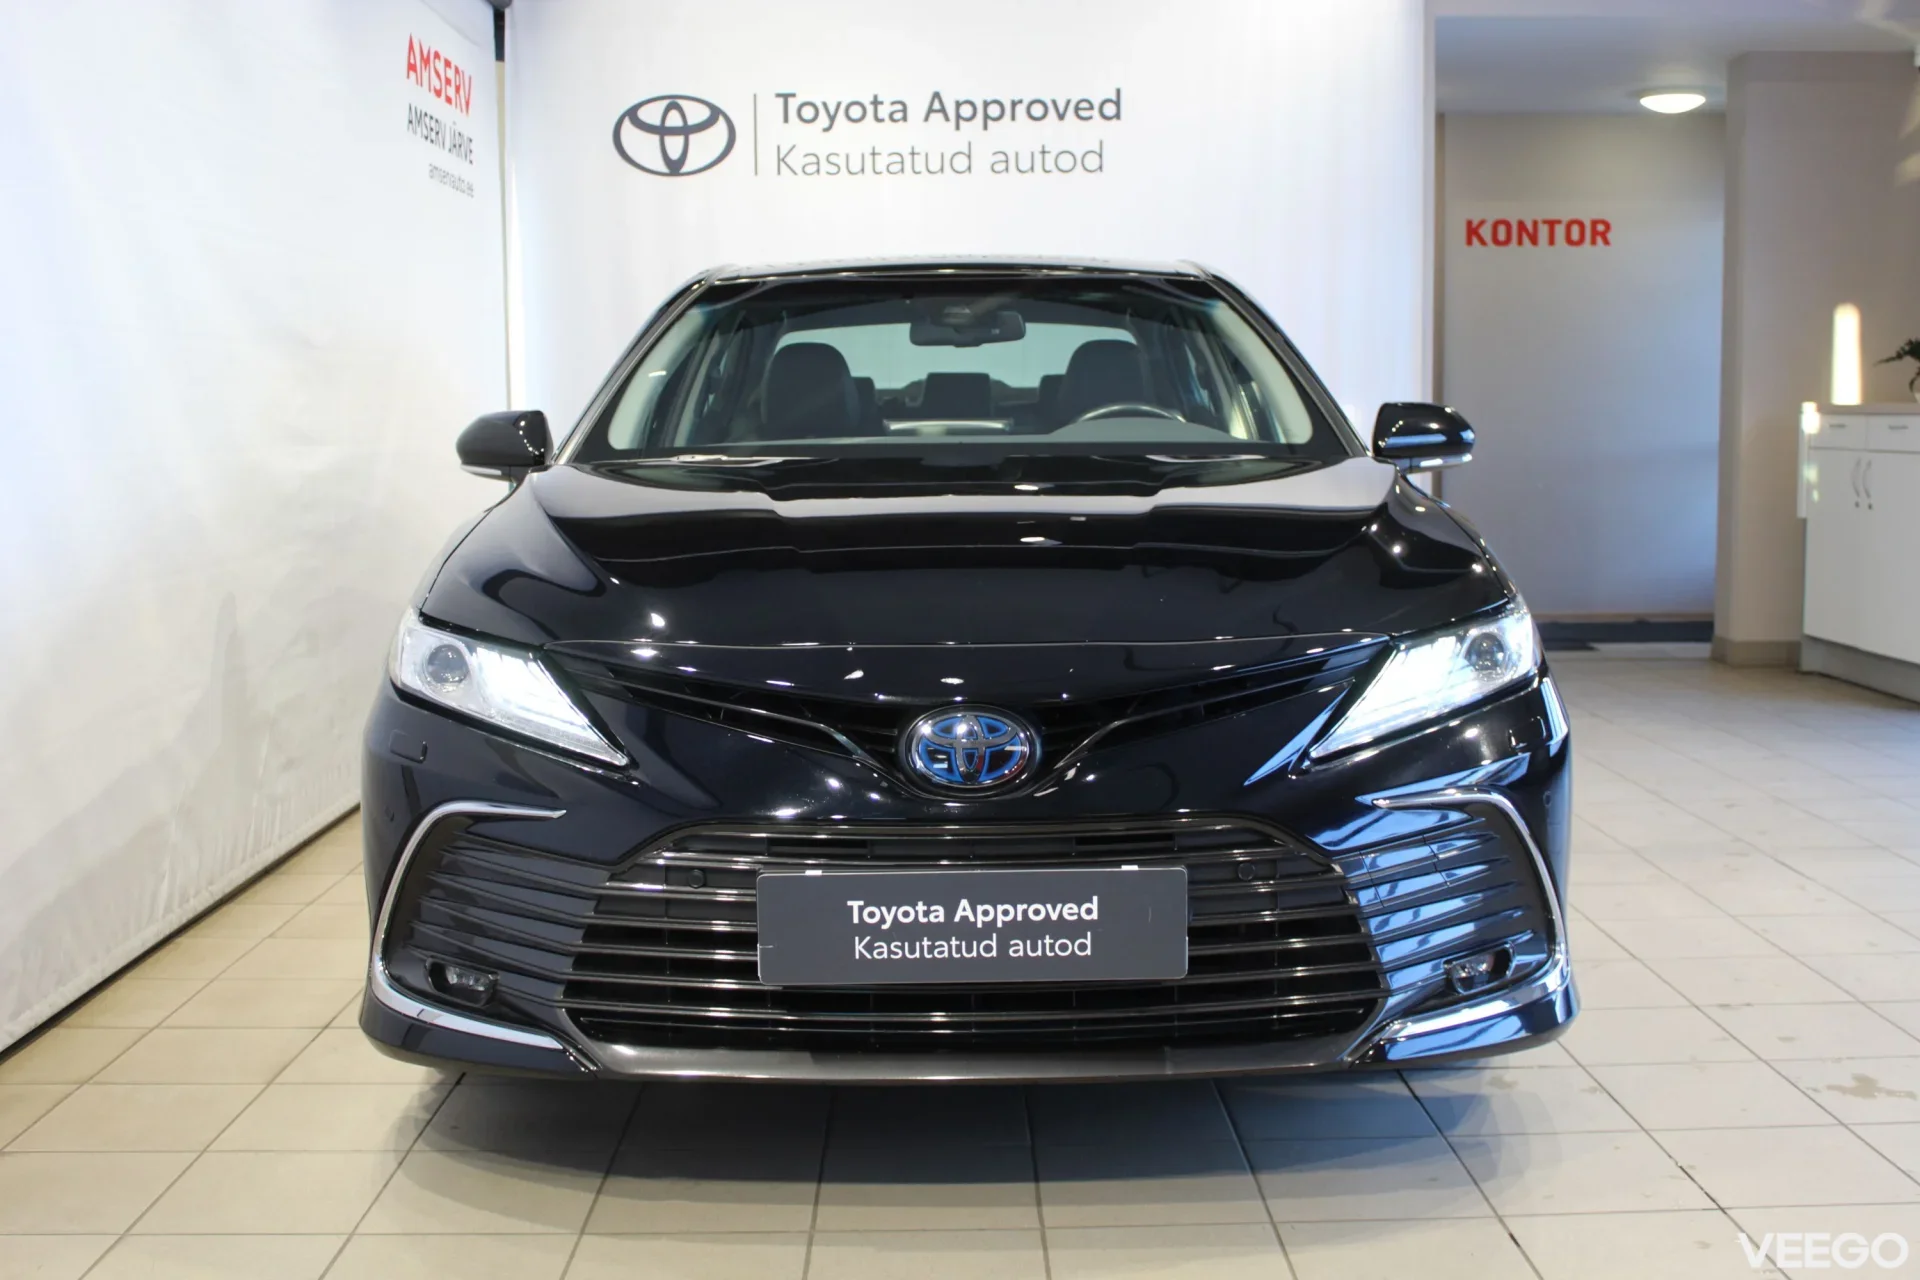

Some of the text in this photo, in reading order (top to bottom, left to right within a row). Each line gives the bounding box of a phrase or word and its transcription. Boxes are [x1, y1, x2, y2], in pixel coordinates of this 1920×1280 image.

[406, 32, 472, 117] AMSERV
[775, 88, 1122, 132] Toyota Approved
[407, 102, 474, 165] AMSERV JÄRVE
[776, 140, 1104, 176] Kasutatud autod
[1465, 218, 1612, 247] KONTOR
[847, 895, 1099, 929] Toyota Approved
[854, 931, 1092, 960] Kasutatud autod
